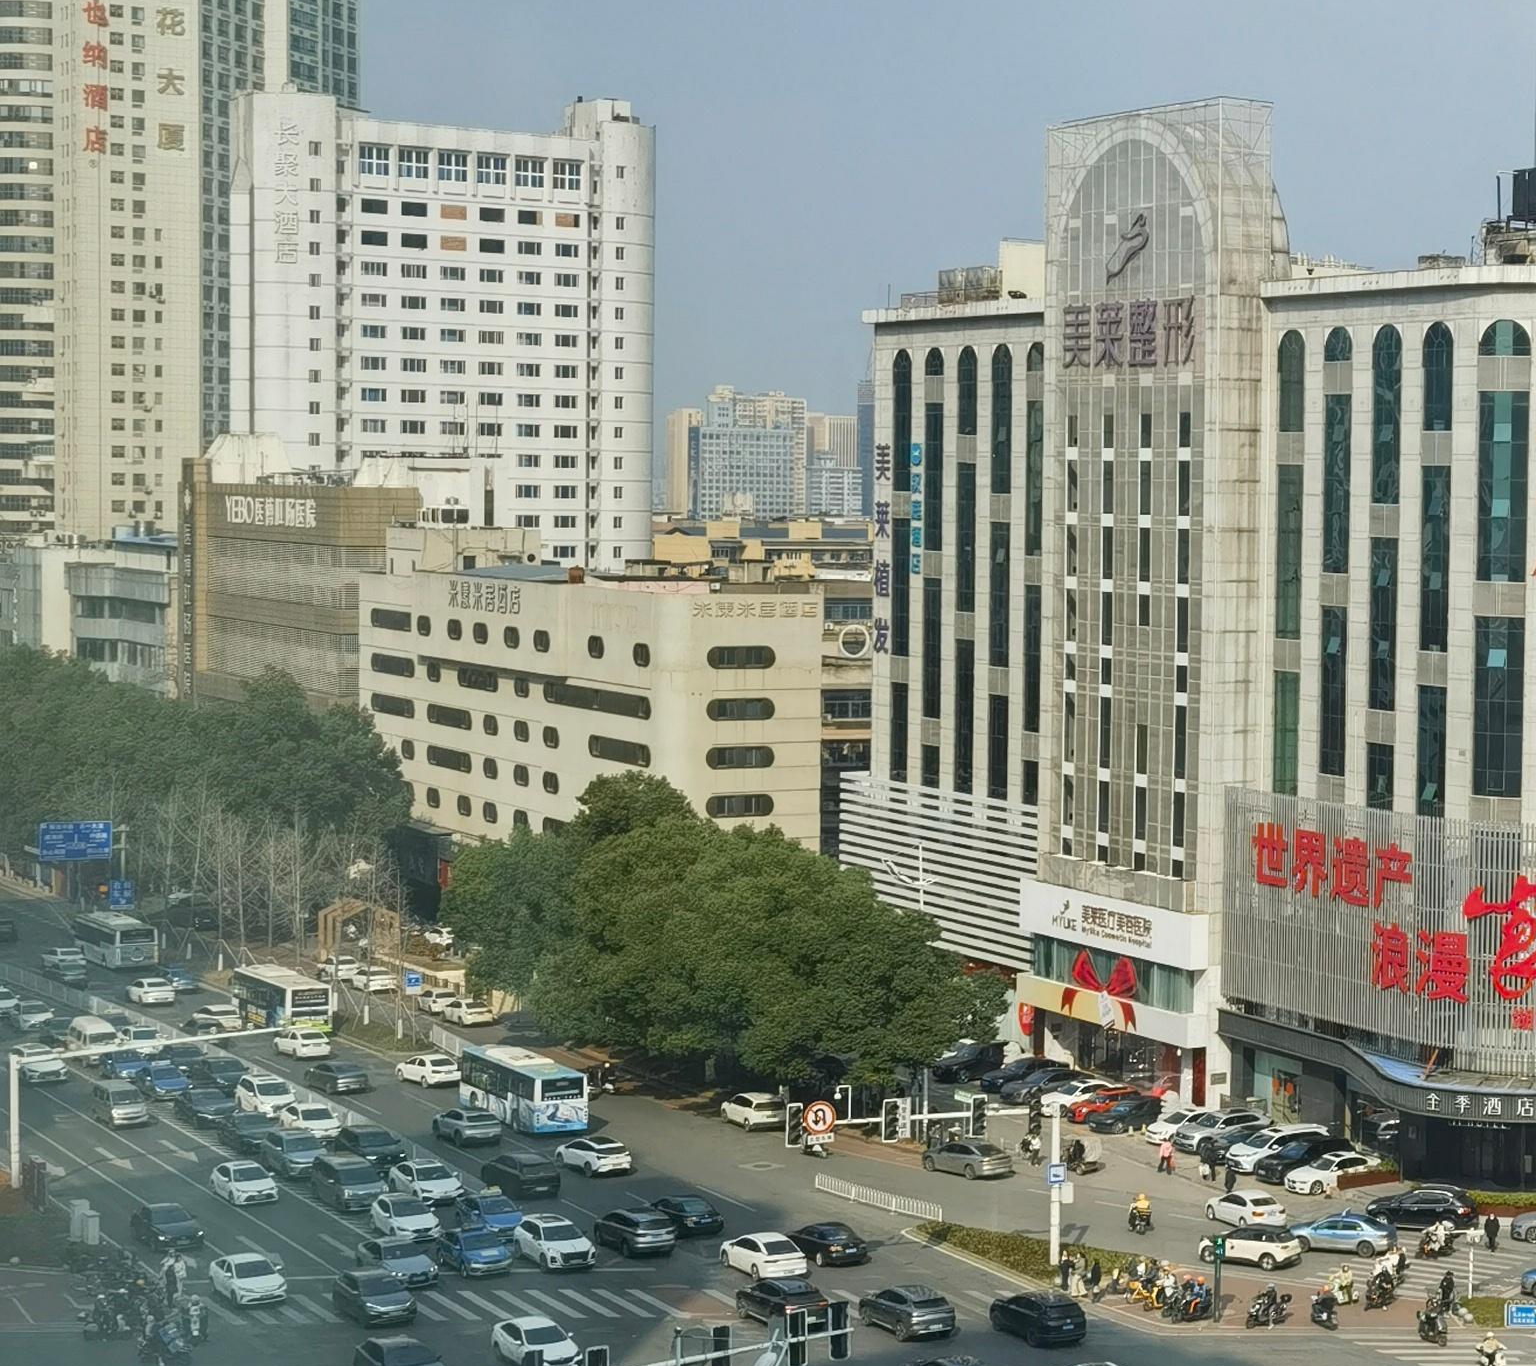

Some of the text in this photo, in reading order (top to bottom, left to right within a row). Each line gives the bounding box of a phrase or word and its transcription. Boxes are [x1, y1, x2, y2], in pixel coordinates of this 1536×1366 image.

[1063, 295, 1195, 369] 美莱整形
[874, 442, 891, 654] 美莱植发
[1251, 821, 1413, 908] 世界遗产
[1371, 922, 1469, 1004] 浪漫
[1426, 1093, 1534, 1117] 全季酒店
